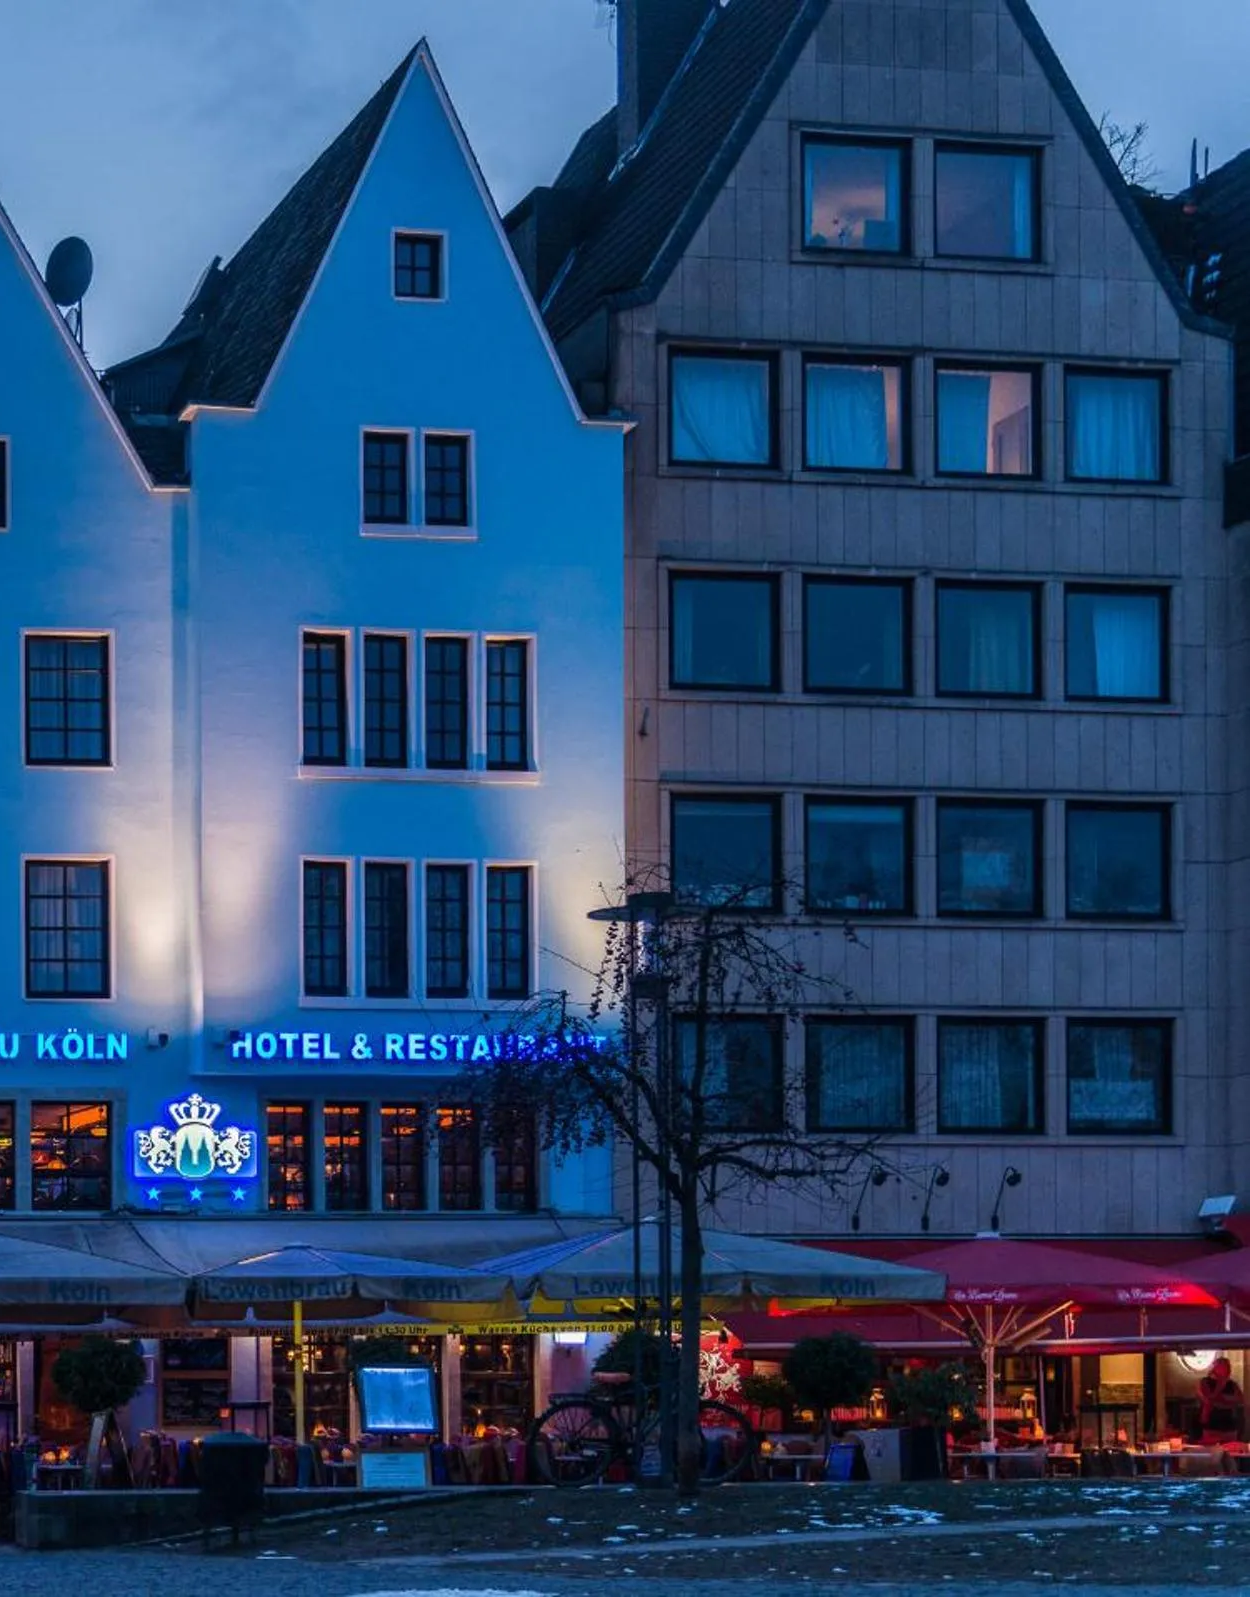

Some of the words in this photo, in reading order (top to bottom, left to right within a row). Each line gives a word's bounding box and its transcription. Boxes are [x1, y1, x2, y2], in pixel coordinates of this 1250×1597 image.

[37, 1027, 129, 1060] KÖLN
[231, 1031, 340, 1060] HOTEL
[350, 1032, 373, 1060] &
[409, 1326, 429, 1335] Uhr
[478, 1325, 518, 1334] Warme
[520, 1323, 555, 1333] Küche
